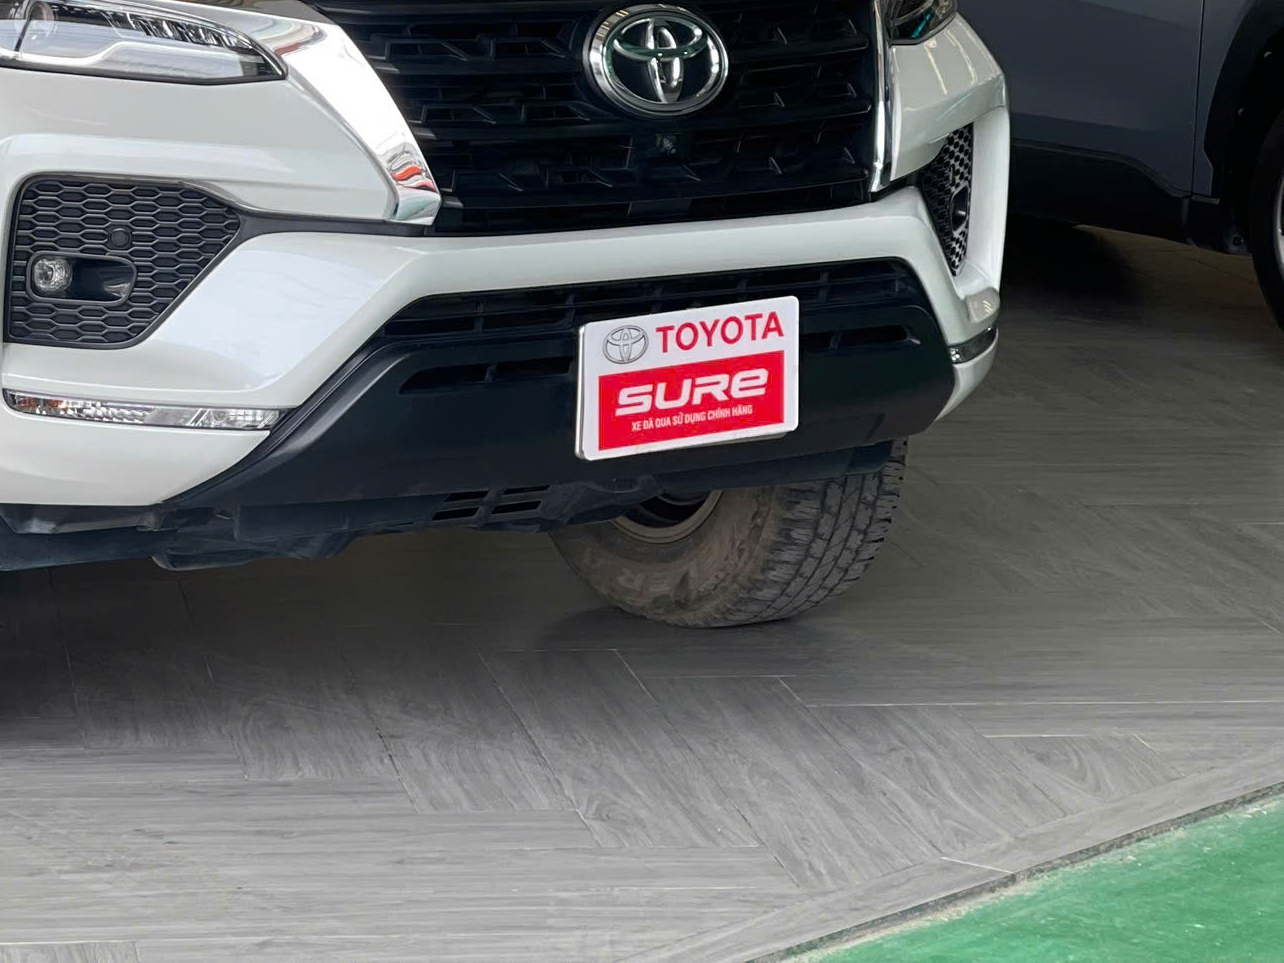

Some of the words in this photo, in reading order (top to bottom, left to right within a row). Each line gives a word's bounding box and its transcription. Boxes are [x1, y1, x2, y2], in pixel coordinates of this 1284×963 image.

[655, 311, 785, 353] TOYOTA
[631, 421, 642, 432] XE
[655, 418, 671, 429] QUA
[684, 412, 706, 425] DỤNG
[707, 407, 731, 420] CHÍNH
